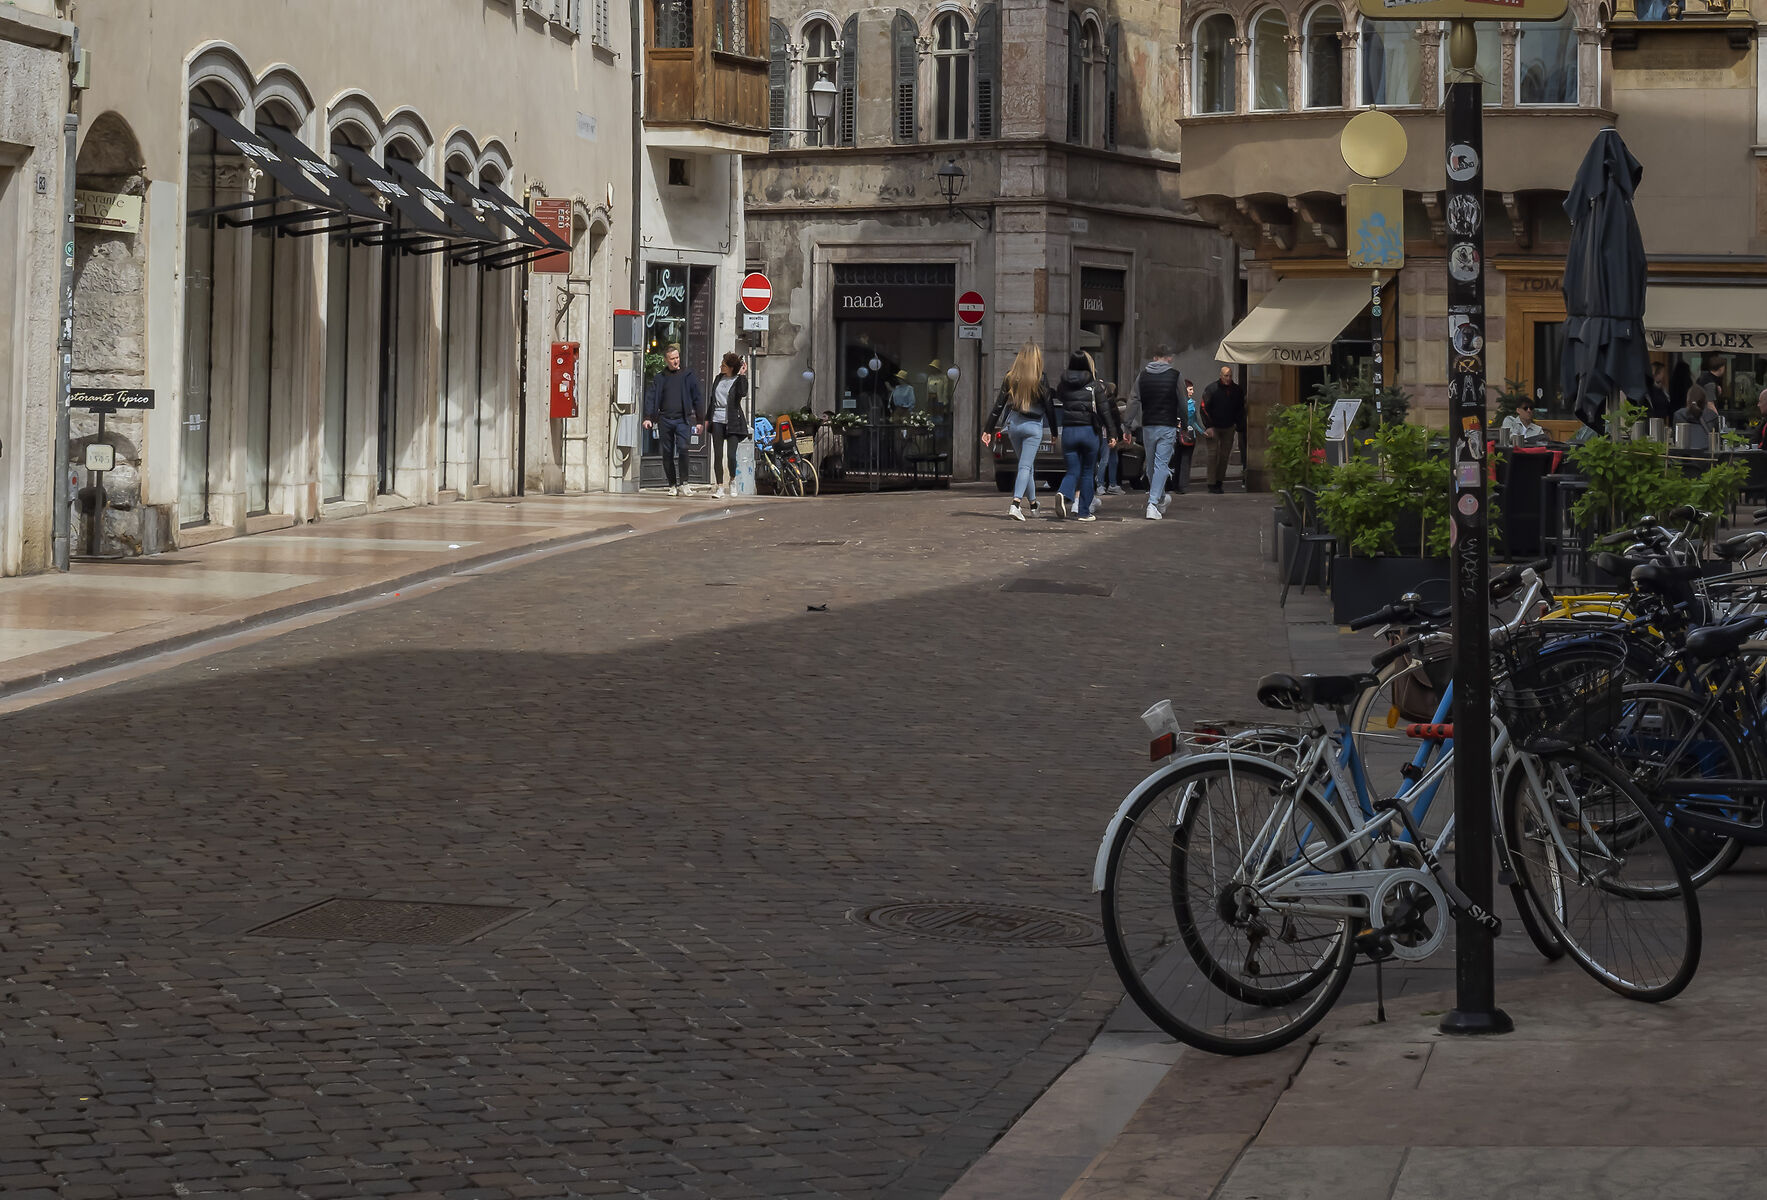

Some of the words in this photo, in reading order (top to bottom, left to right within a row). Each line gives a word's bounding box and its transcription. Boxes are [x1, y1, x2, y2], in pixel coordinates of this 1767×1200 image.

[77, 191, 125, 208] storante
[1520, 278, 1561, 290] TOM
[843, 291, 884, 308] nanà
[1680, 332, 1754, 348] ROLEX
[1272, 348, 1326, 361] TOMASI
[70, 392, 115, 402] storante
[116, 390, 149, 407] Tipico
